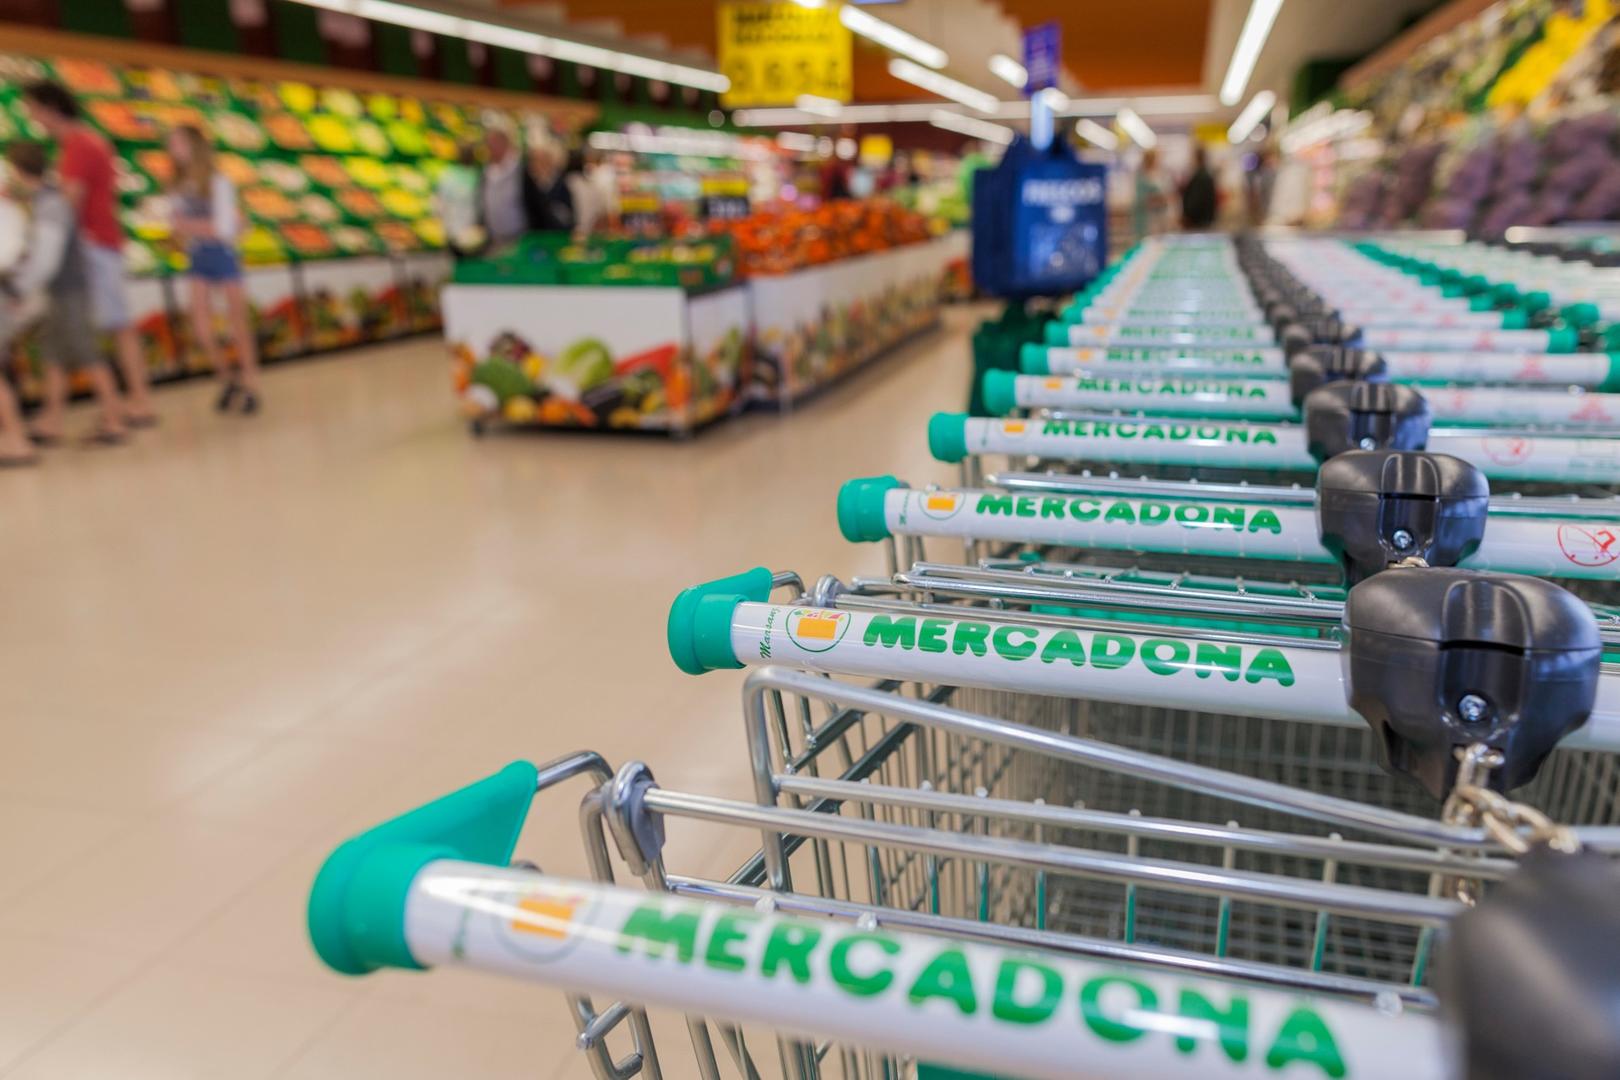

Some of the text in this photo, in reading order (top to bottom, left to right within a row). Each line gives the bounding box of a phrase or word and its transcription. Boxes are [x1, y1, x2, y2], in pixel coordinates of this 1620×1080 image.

[1042, 420, 1278, 445] MERCADONA
[976, 494, 1282, 535] MERCADONA
[862, 615, 1296, 688] MERCADONA
[616, 906, 1349, 1079] MERCADONA
